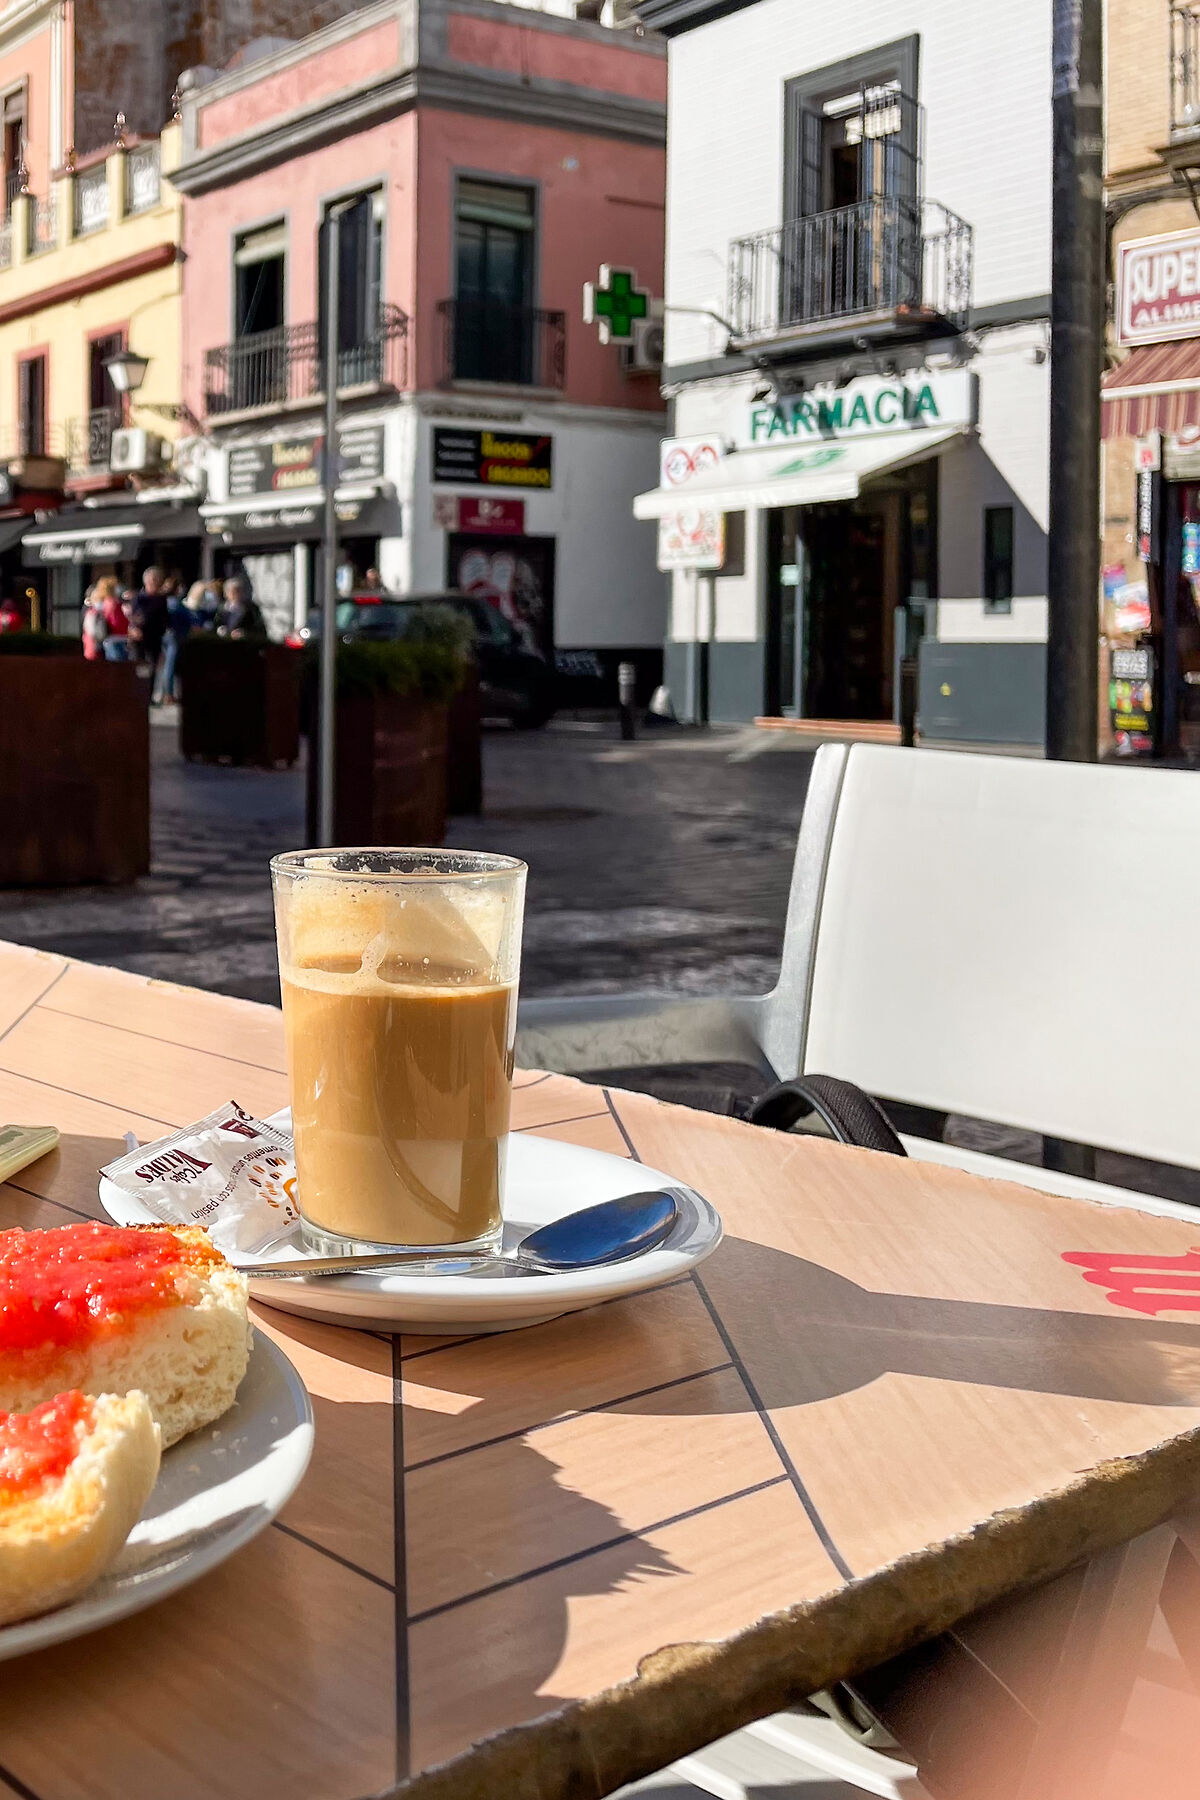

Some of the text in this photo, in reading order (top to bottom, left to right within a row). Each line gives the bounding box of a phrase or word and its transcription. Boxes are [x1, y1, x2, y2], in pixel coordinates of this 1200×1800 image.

[1131, 250, 1200, 305] SUPE
[750, 383, 940, 441] FARMACIA
[135, 1149, 213, 1183] VALDÉS
[243, 1145, 285, 1163] omentos
[191, 1198, 220, 1220] pasión
